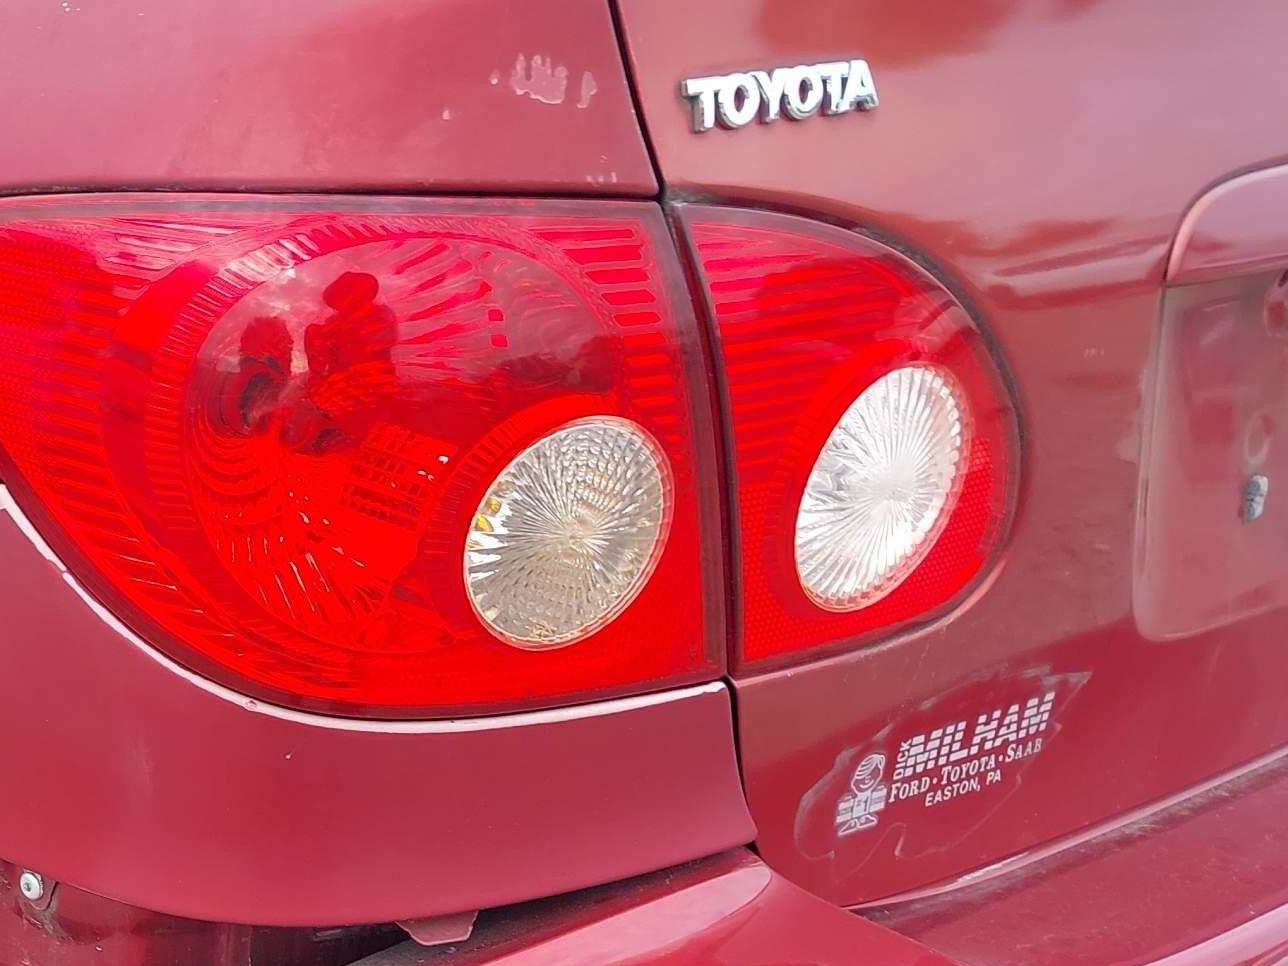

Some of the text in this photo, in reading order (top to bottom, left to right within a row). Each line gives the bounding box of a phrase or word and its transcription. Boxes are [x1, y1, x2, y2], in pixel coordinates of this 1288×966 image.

[681, 59, 880, 132] TOYOTA
[893, 740, 912, 780] DICK
[901, 691, 1055, 778] MILHAM
[889, 738, 1043, 803] FORD TOYOTA SAAB
[924, 769, 1002, 806] EASTON, PA
